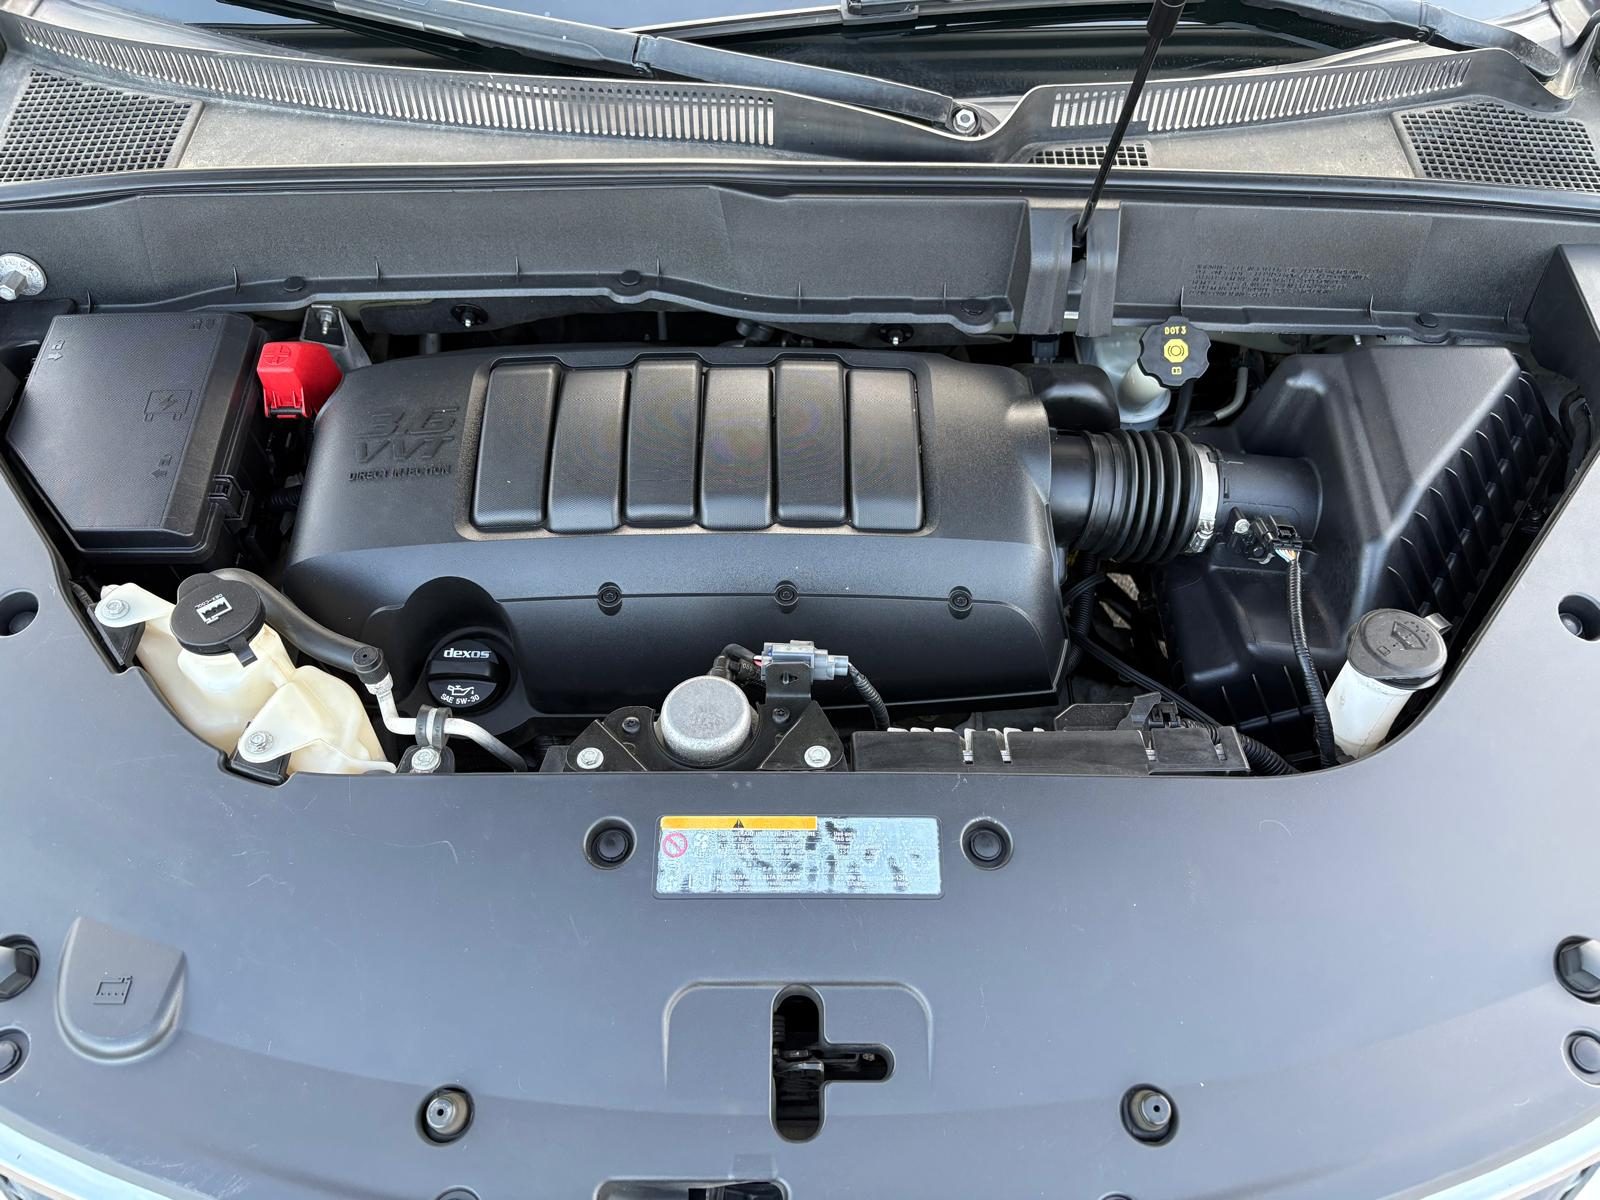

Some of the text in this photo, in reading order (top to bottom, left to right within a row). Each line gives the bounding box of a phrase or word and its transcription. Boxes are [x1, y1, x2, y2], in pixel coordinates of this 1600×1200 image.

[1164, 325, 1187, 335] DOT 3
[354, 435, 456, 464] VVT
[348, 462, 453, 481] DIRECT INJECTION
[443, 647, 491, 659] dexos
[441, 693, 480, 705] SAE 5W-30
